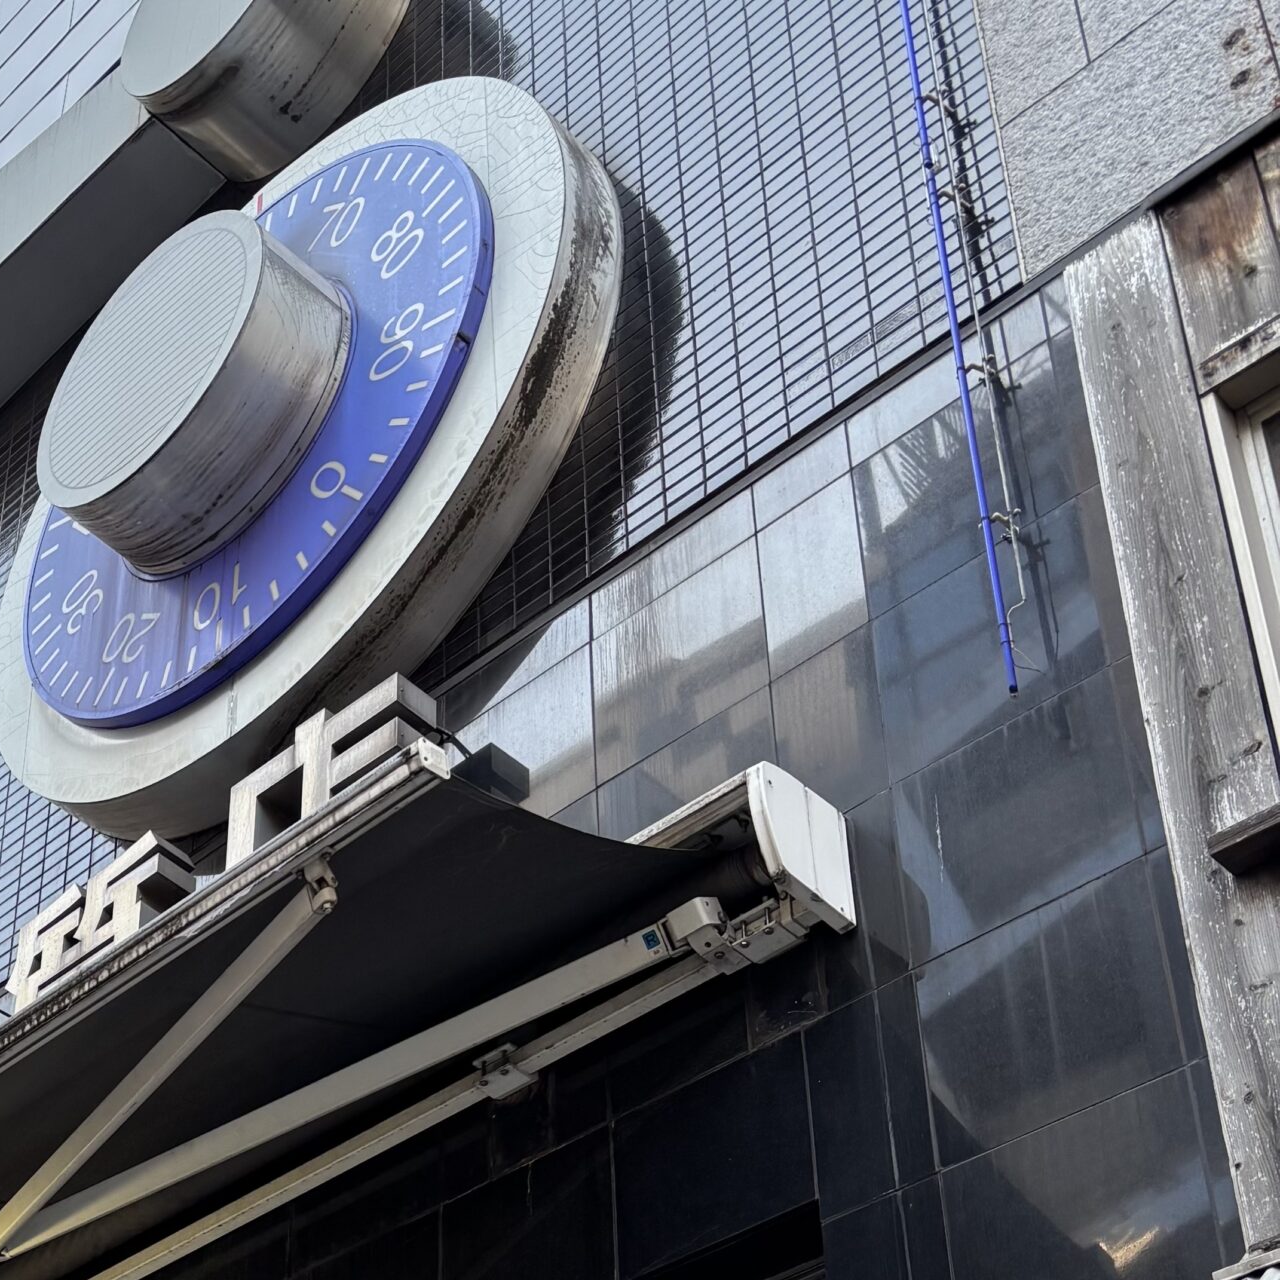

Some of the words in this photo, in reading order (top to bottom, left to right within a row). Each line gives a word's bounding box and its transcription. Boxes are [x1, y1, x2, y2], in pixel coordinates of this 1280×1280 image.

[308, 196, 365, 253] 70
[371, 209, 424, 279] 80
[368, 302, 424, 382] 90
[63, 568, 104, 635] 30
[193, 561, 247, 631] 10
[101, 612, 161, 664] 20
